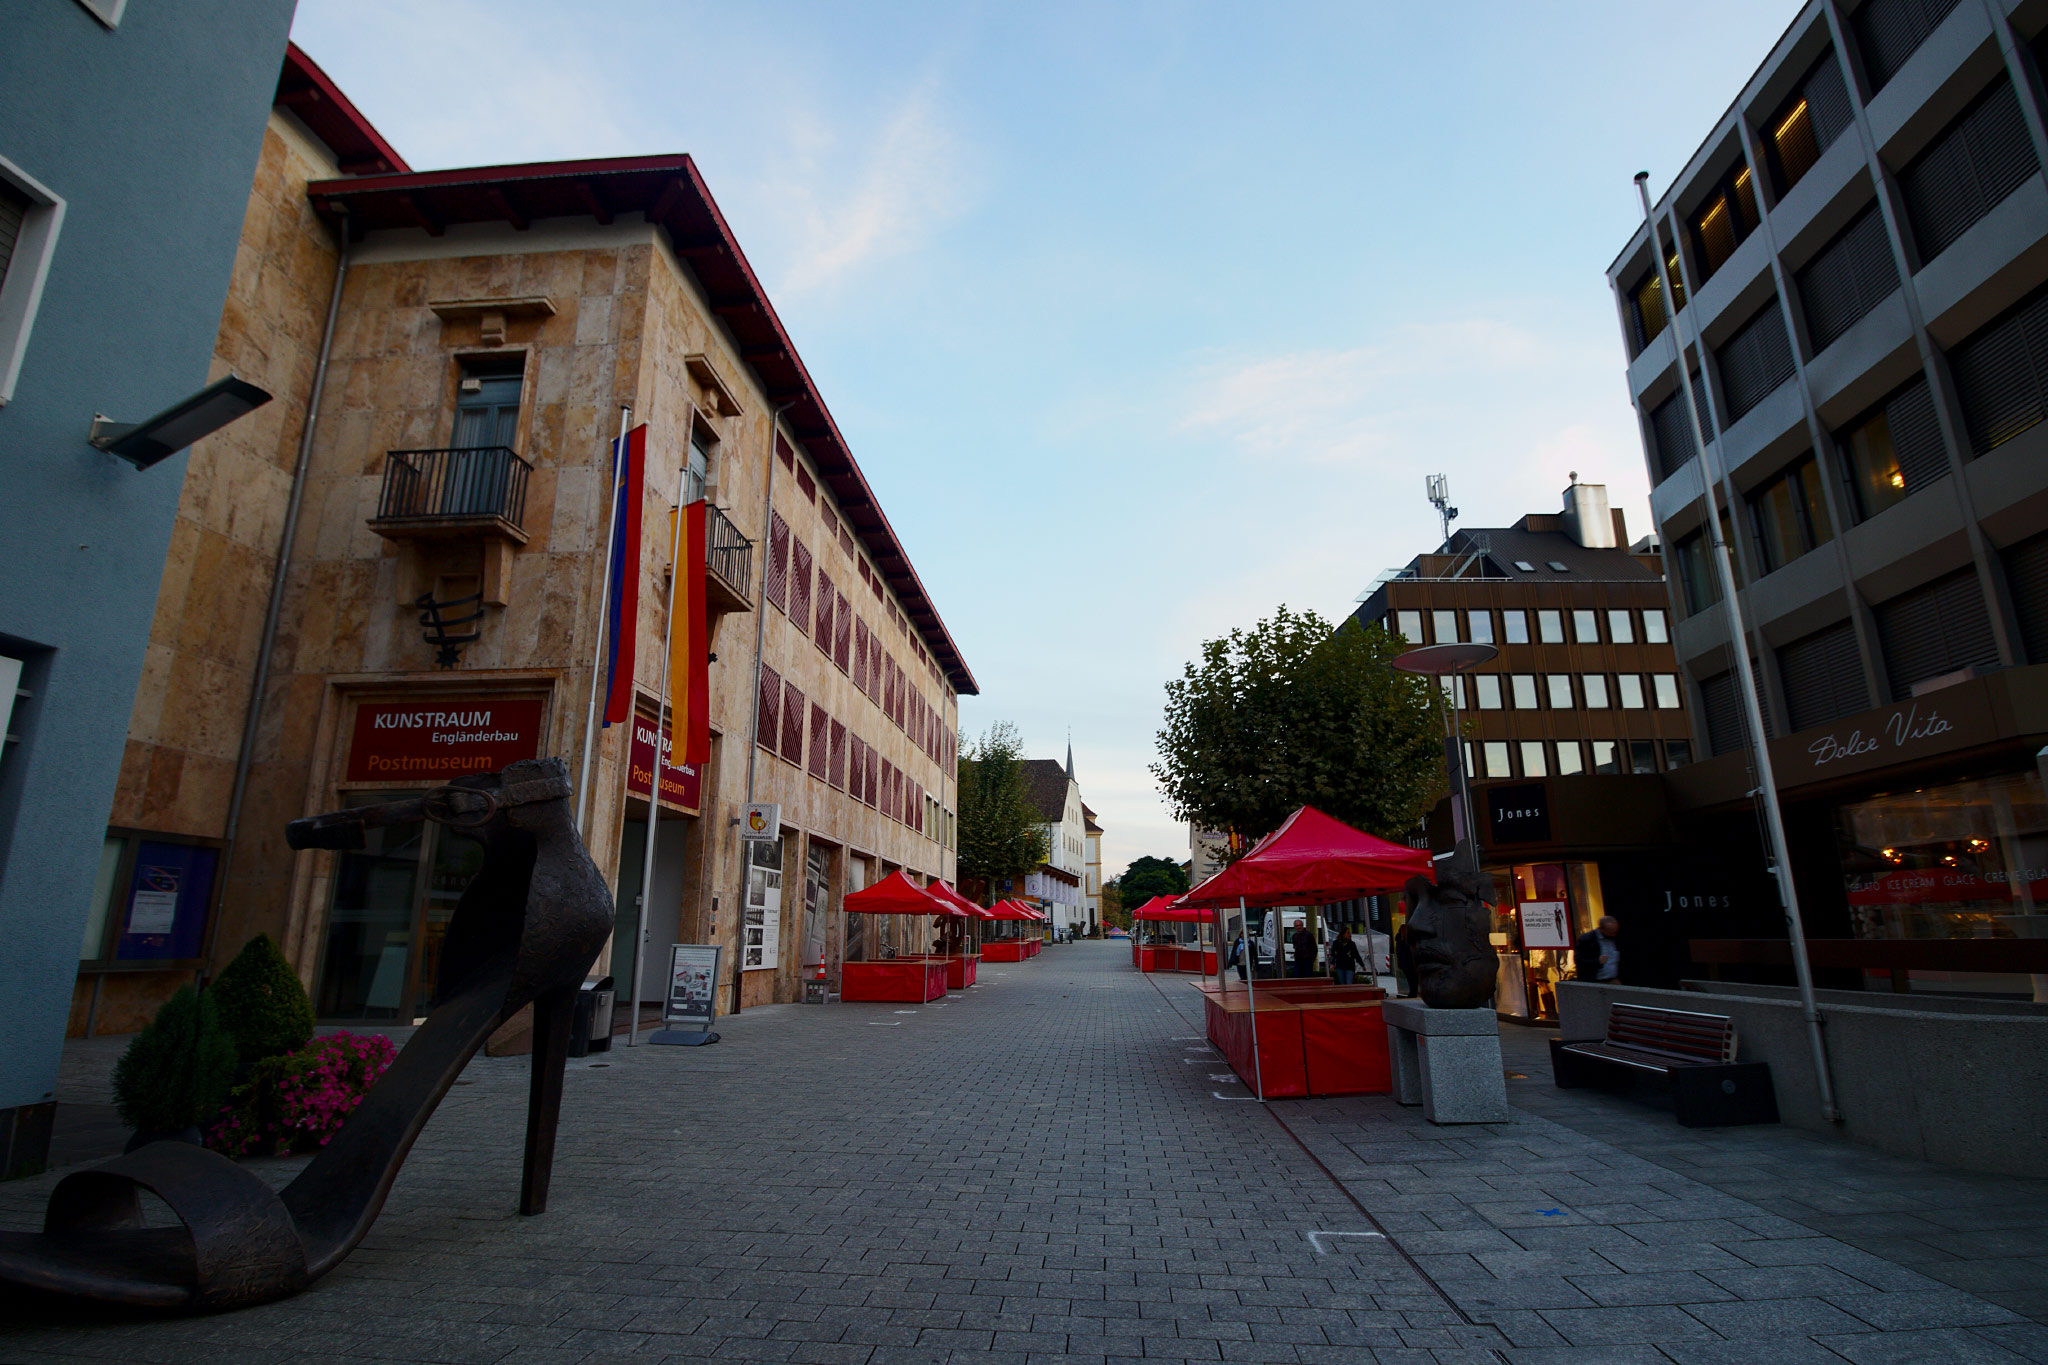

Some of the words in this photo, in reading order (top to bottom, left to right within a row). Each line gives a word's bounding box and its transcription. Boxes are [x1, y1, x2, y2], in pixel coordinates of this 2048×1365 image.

[374, 711, 491, 729] KUNSTRAUM
[431, 730, 519, 746] Engländerbau
[636, 725, 673, 753] KUNRA
[1808, 730, 1879, 765] Dolce
[1886, 703, 1953, 747] Vita
[367, 754, 493, 771] Postmuseum
[661, 754, 696, 777] Engerbau
[633, 764, 686, 796] Postuseum
[1497, 806, 1541, 823] Jones
[741, 833, 773, 841] Postmuseum
[1886, 879, 1901, 891] ICE
[1902, 876, 1936, 889] CREAM
[1663, 890, 1731, 912] Jones
